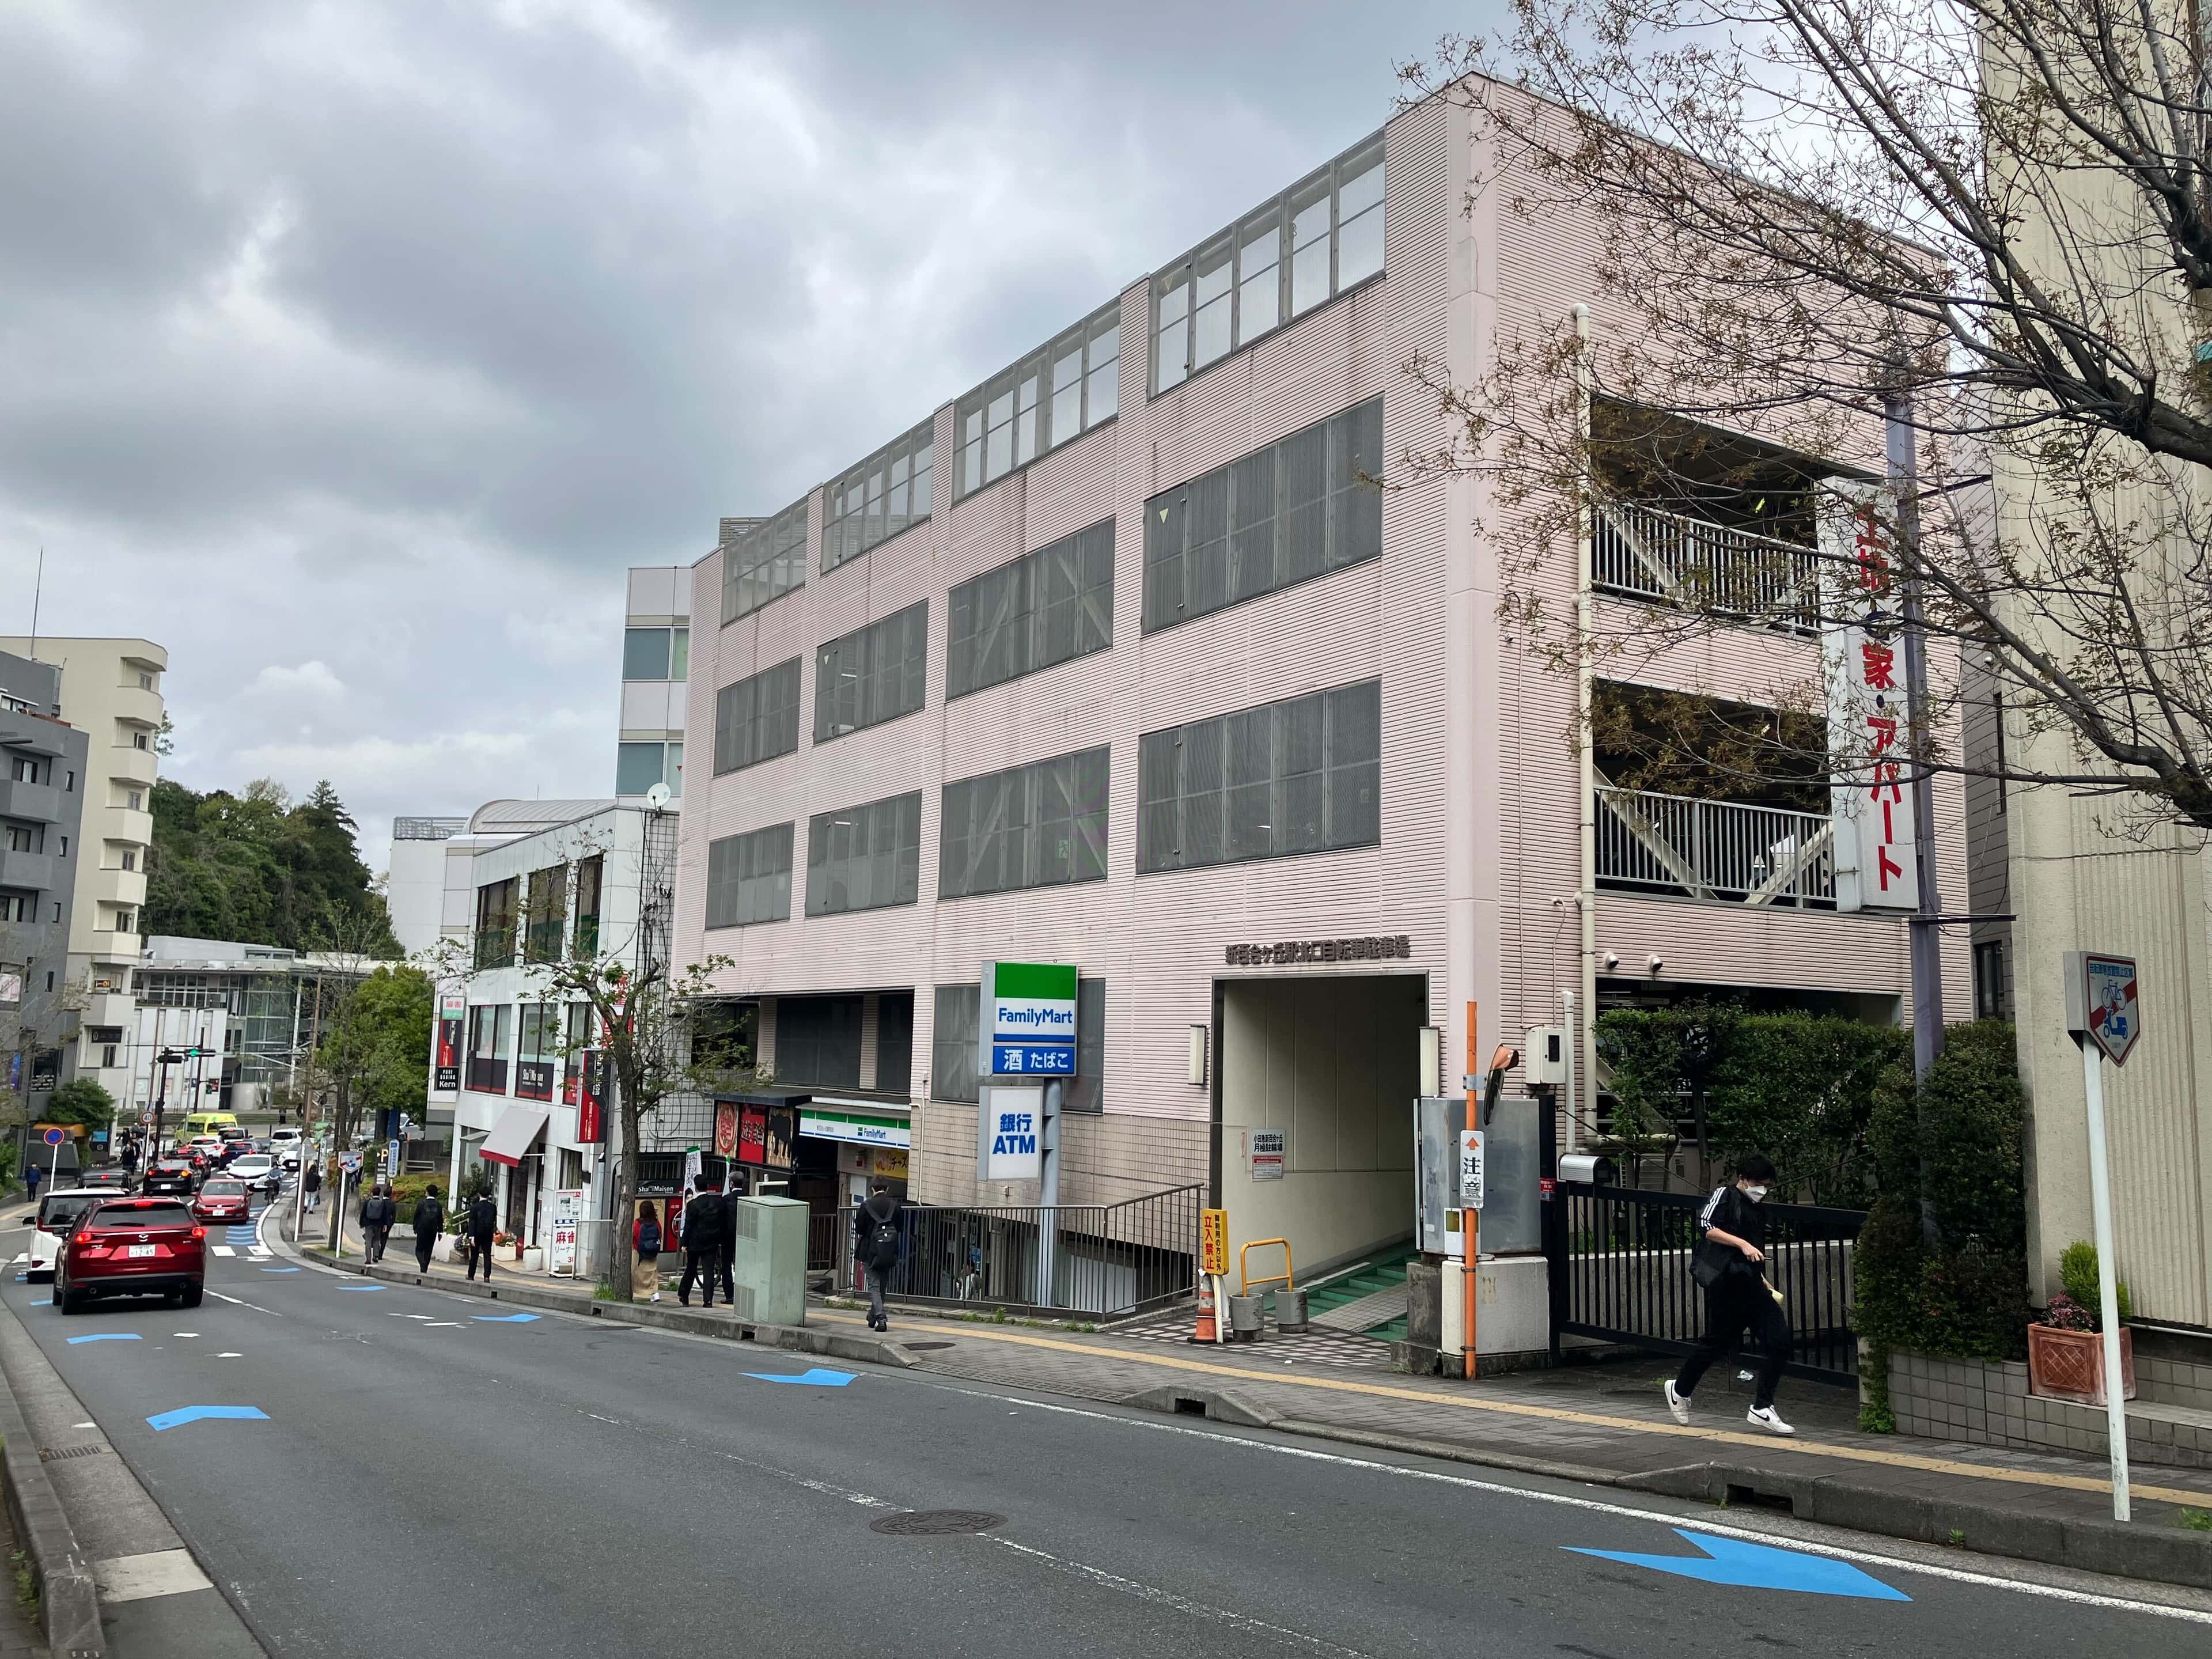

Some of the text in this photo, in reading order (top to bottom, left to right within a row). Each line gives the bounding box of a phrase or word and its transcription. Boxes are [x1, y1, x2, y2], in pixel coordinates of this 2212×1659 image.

[999, 1007, 1073, 1027] FamilyMart
[1003, 1049, 1069, 1071] 酒 たばこ
[1000, 1113, 1032, 1132] 銀行
[864, 1128, 886, 1139] FamilyMart
[993, 1135, 1036, 1154] ATM
[1463, 1157, 1481, 1198] 注意
[556, 1230, 574, 1244] 麻雀
[1205, 1215, 1214, 1269] 立入禁止
